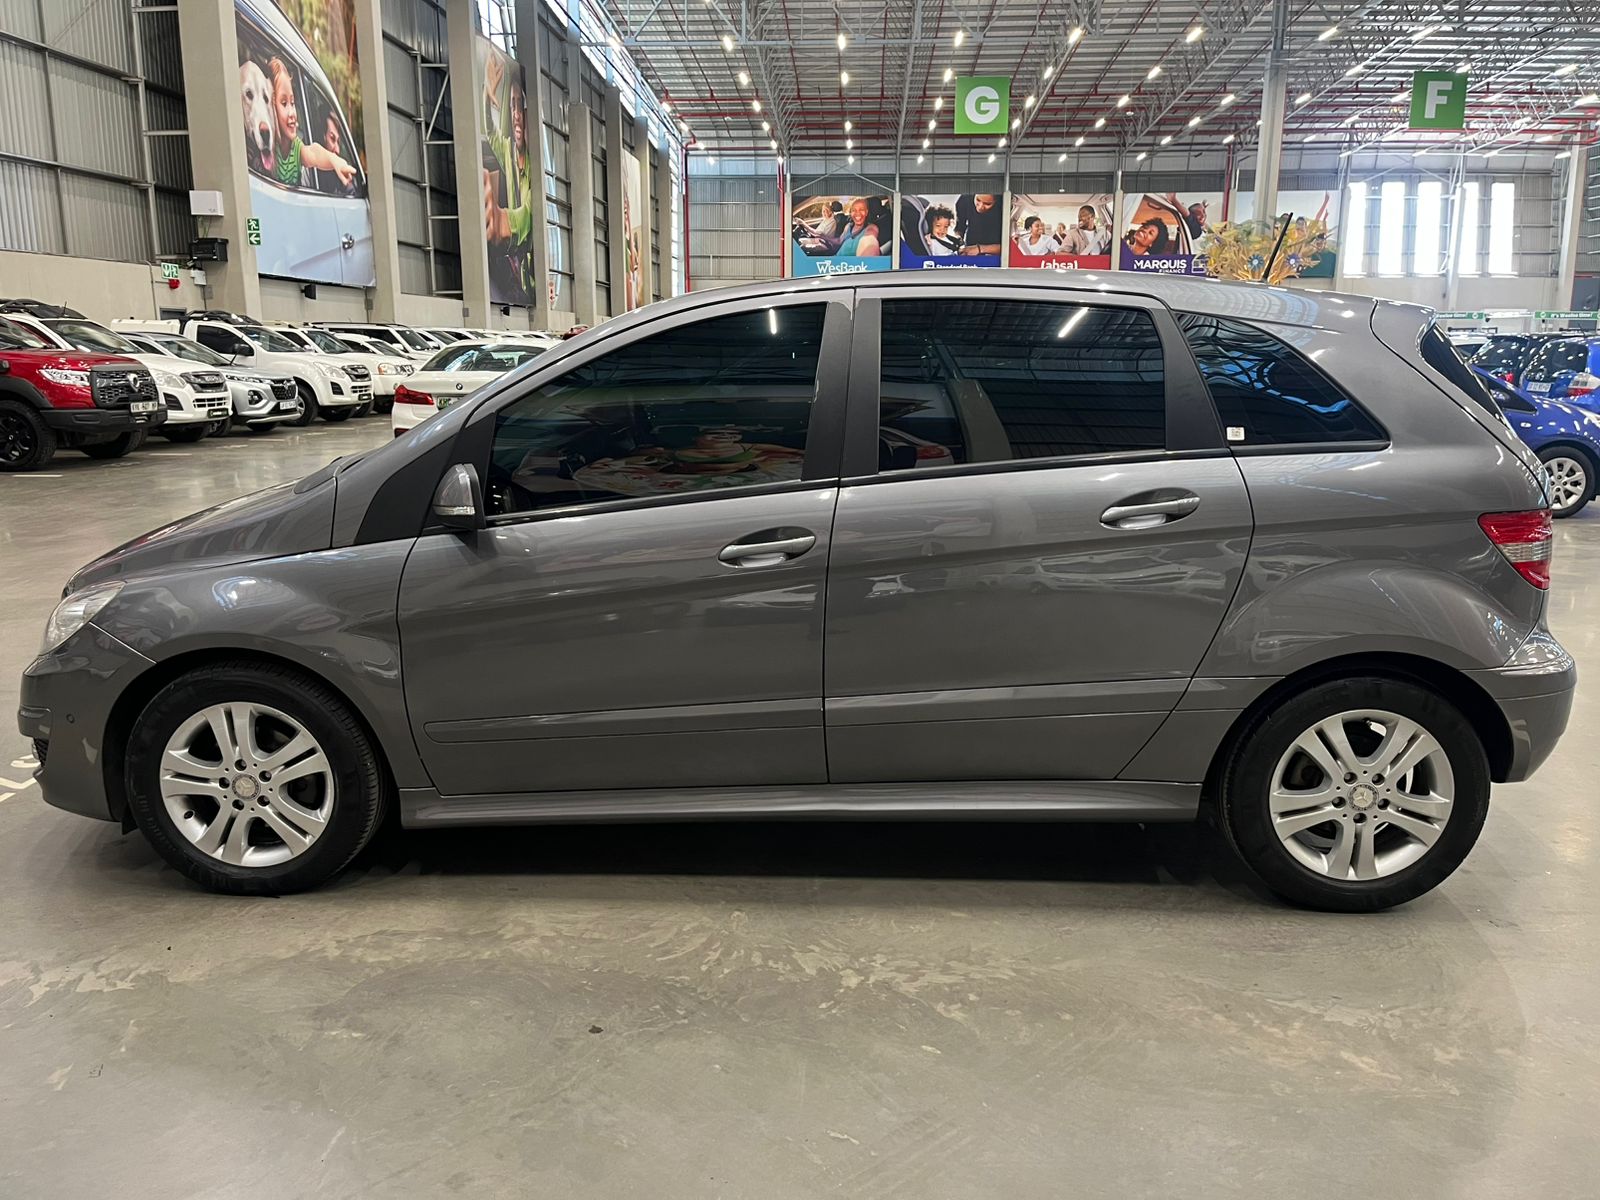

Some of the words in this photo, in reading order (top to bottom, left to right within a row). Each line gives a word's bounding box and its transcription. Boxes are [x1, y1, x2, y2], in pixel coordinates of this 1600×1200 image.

[964, 86, 1000, 124] G
[1424, 81, 1453, 119] F
[816, 260, 868, 273] WesBank
[1134, 260, 1187, 270] MARQUIS
